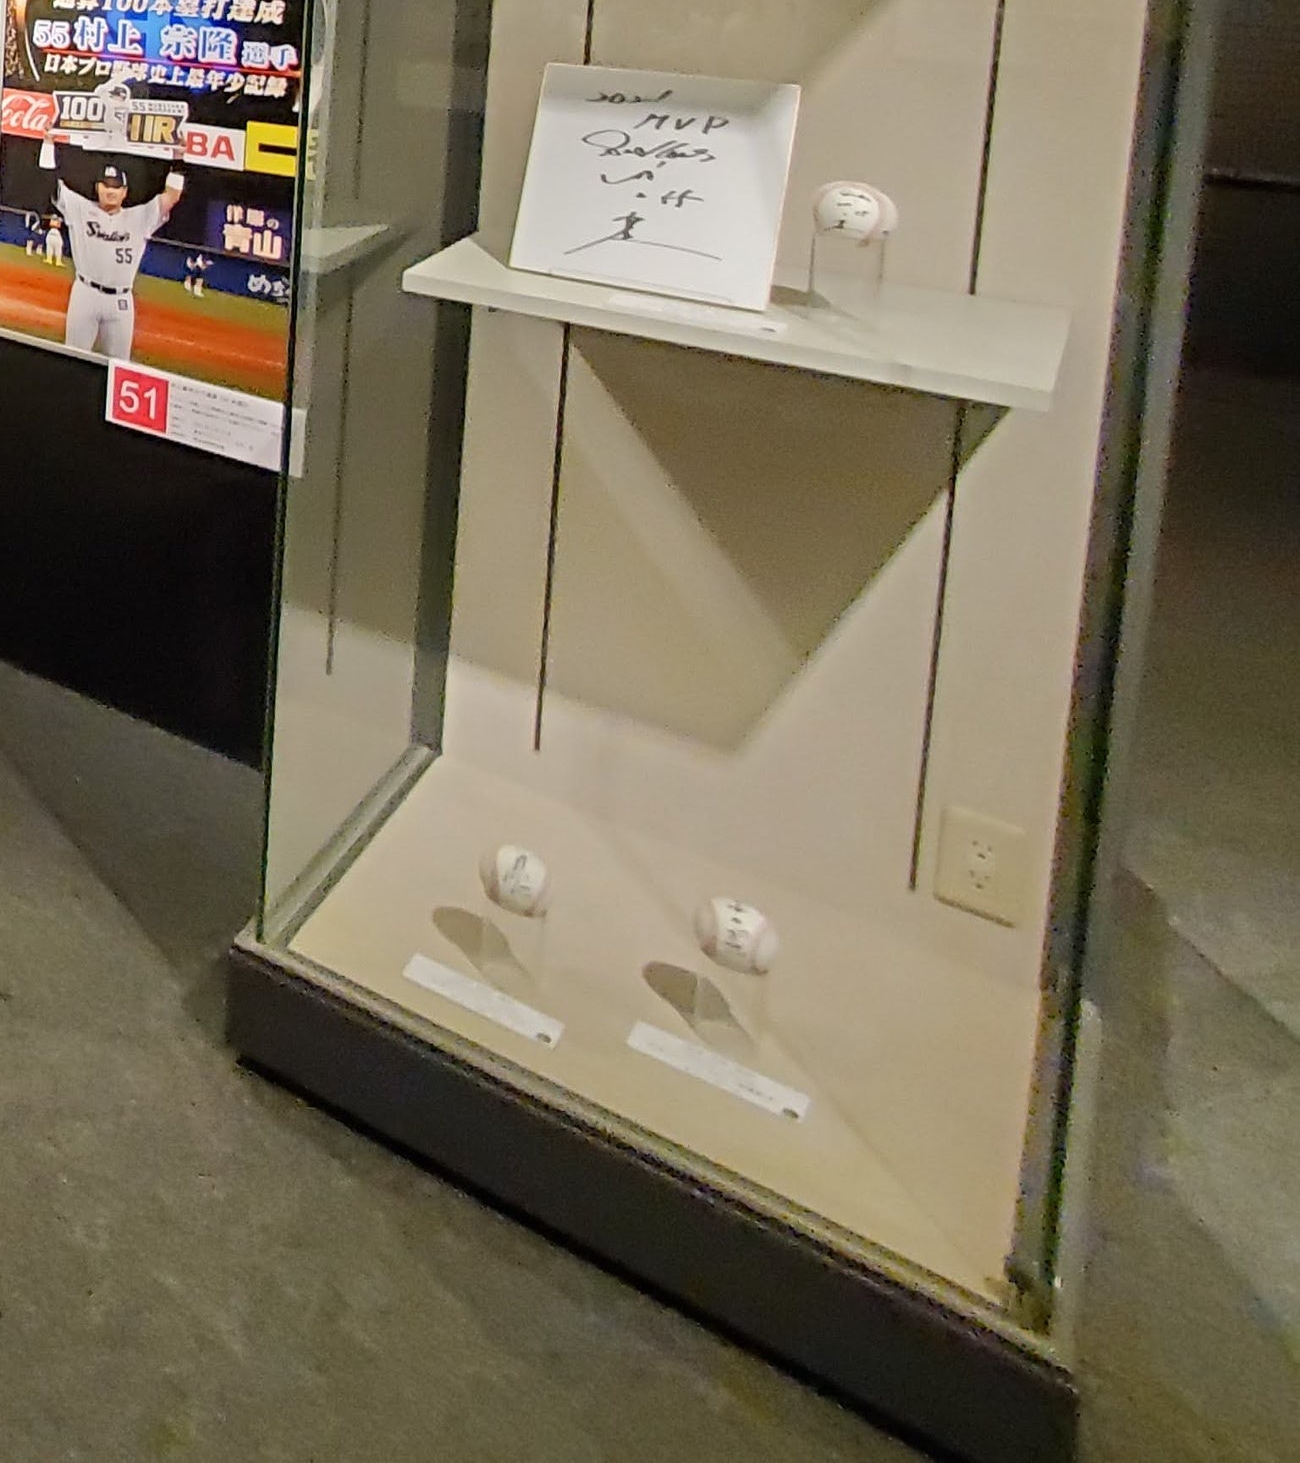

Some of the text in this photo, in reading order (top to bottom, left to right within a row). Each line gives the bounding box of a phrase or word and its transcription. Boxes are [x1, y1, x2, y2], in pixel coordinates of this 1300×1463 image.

[61, 96, 104, 122] 100
[114, 247, 134, 265] 55
[118, 379, 159, 421] 51
